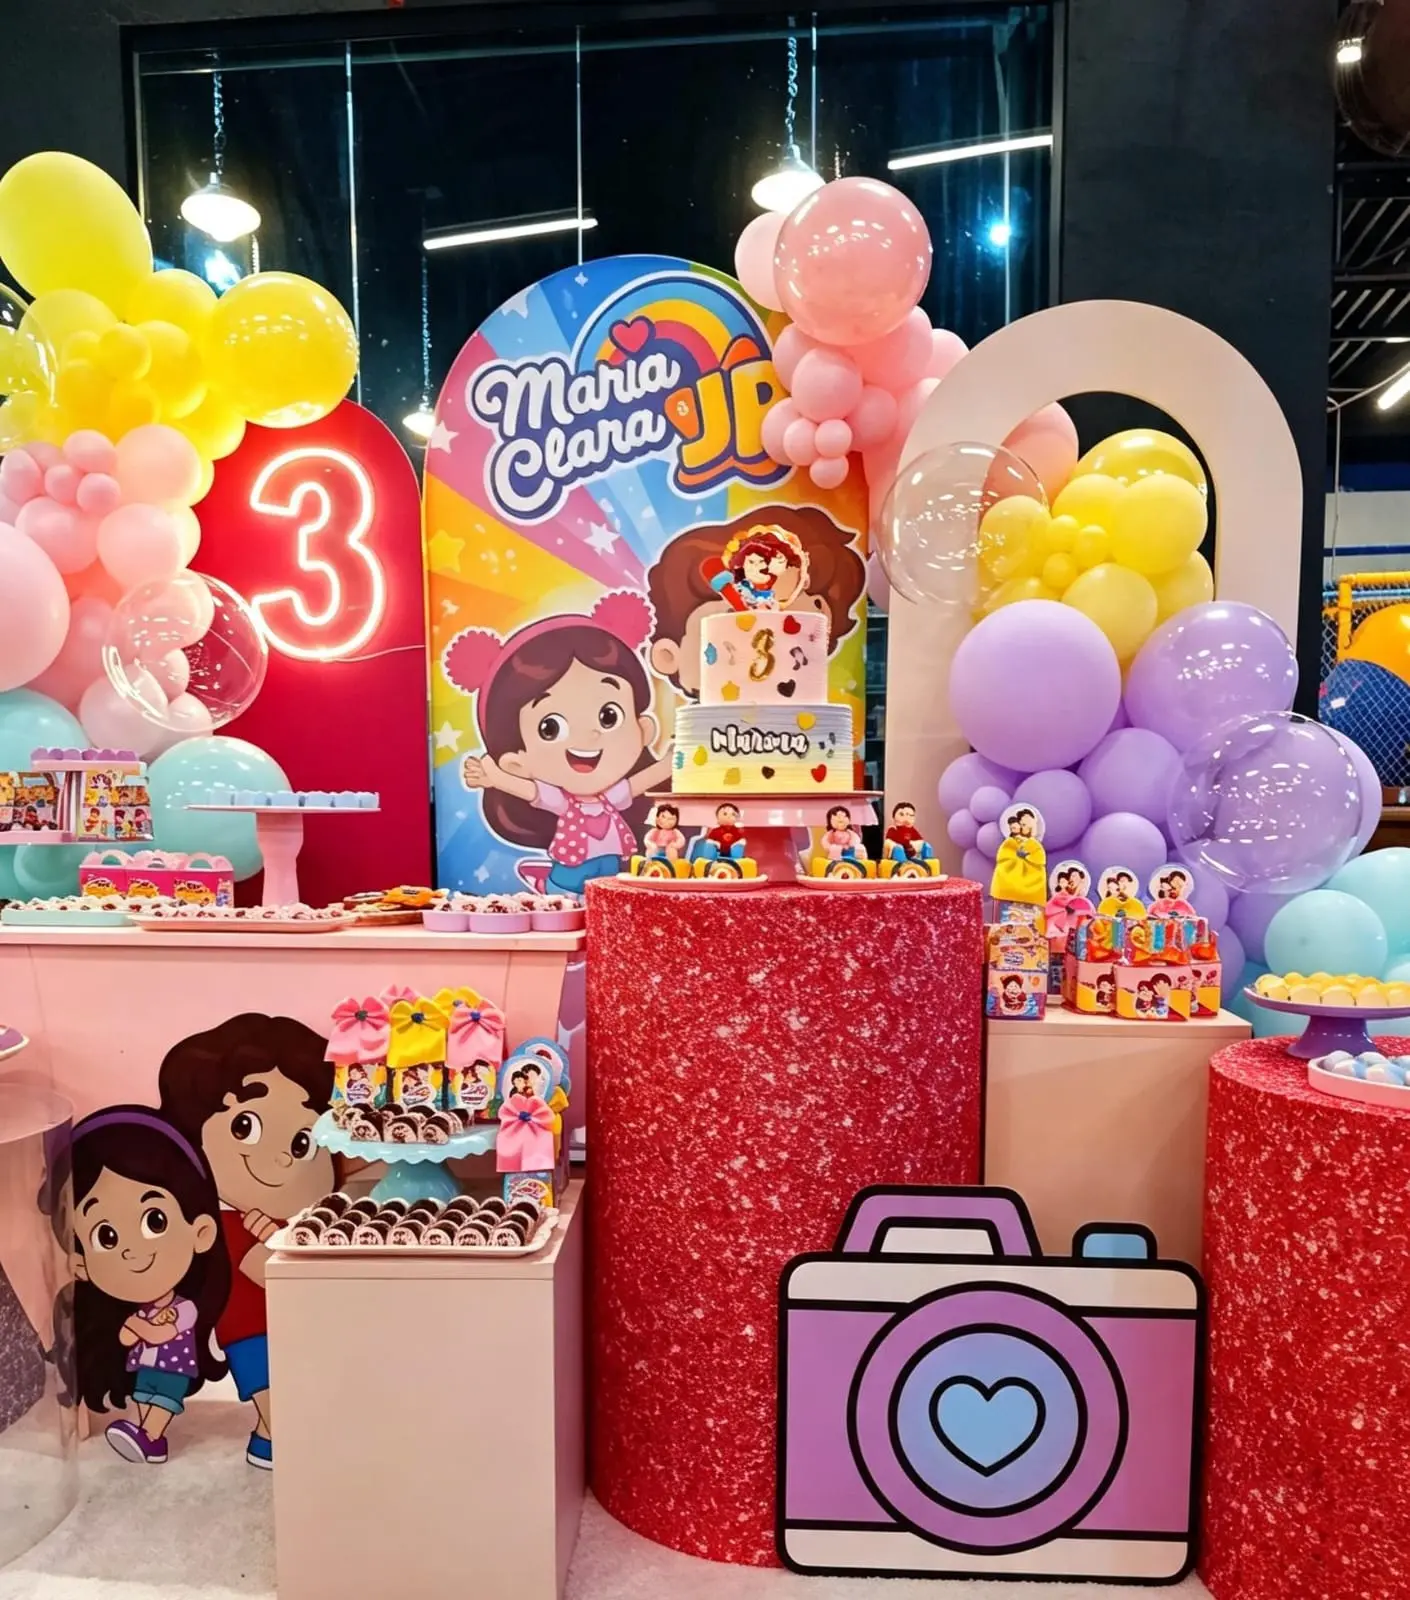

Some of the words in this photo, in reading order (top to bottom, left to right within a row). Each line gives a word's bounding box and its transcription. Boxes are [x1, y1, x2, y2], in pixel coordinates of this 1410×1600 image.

[472, 352, 681, 437] Maria
[497, 408, 667, 511] Clara
[249, 447, 387, 662] 3
